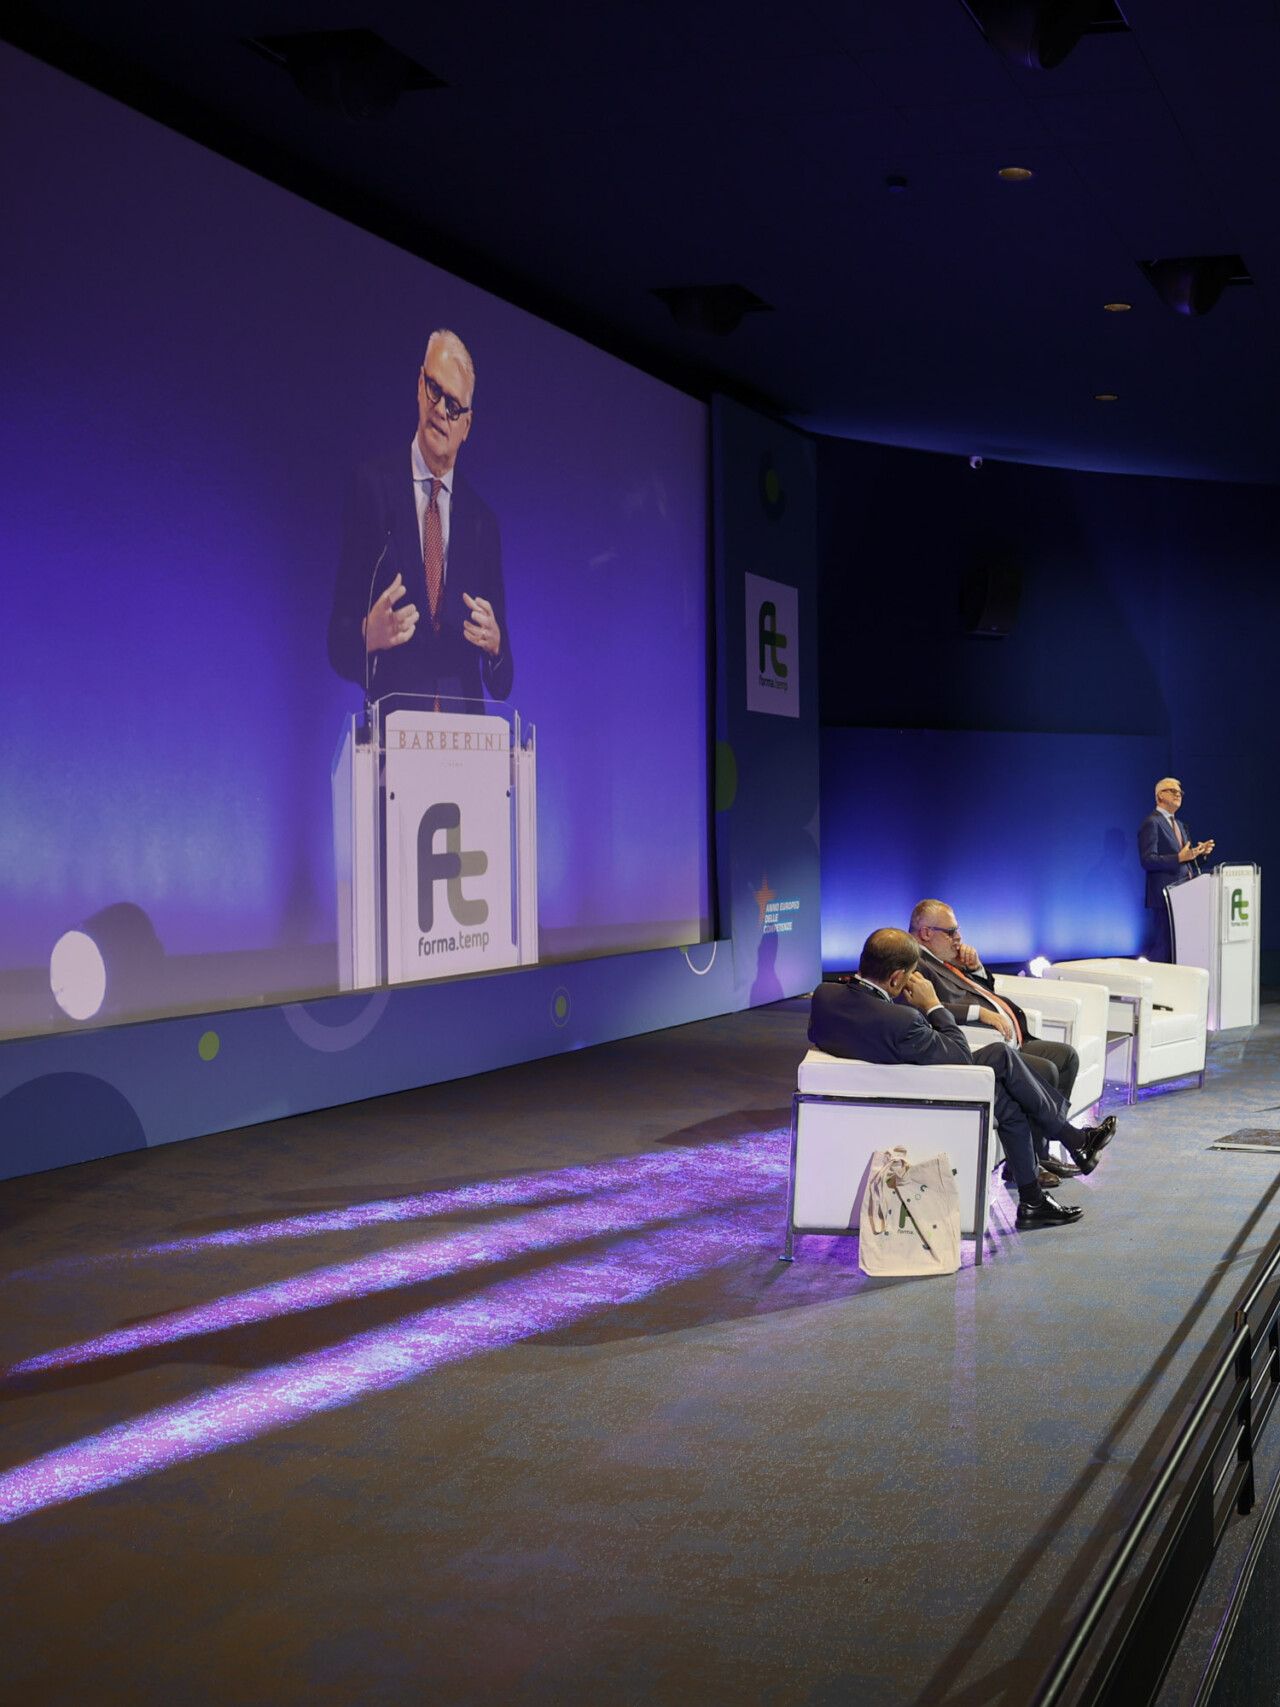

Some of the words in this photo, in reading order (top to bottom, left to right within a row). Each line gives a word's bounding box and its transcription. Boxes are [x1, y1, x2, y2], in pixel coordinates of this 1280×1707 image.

[399, 730, 502, 752] BARBERINI
[766, 903, 779, 912] ANNO
[780, 901, 800, 910] EUROPEO
[765, 914, 778, 923] DELLE
[763, 922, 792, 933] COMPETENZE
[417, 931, 490, 957] forma.temp
